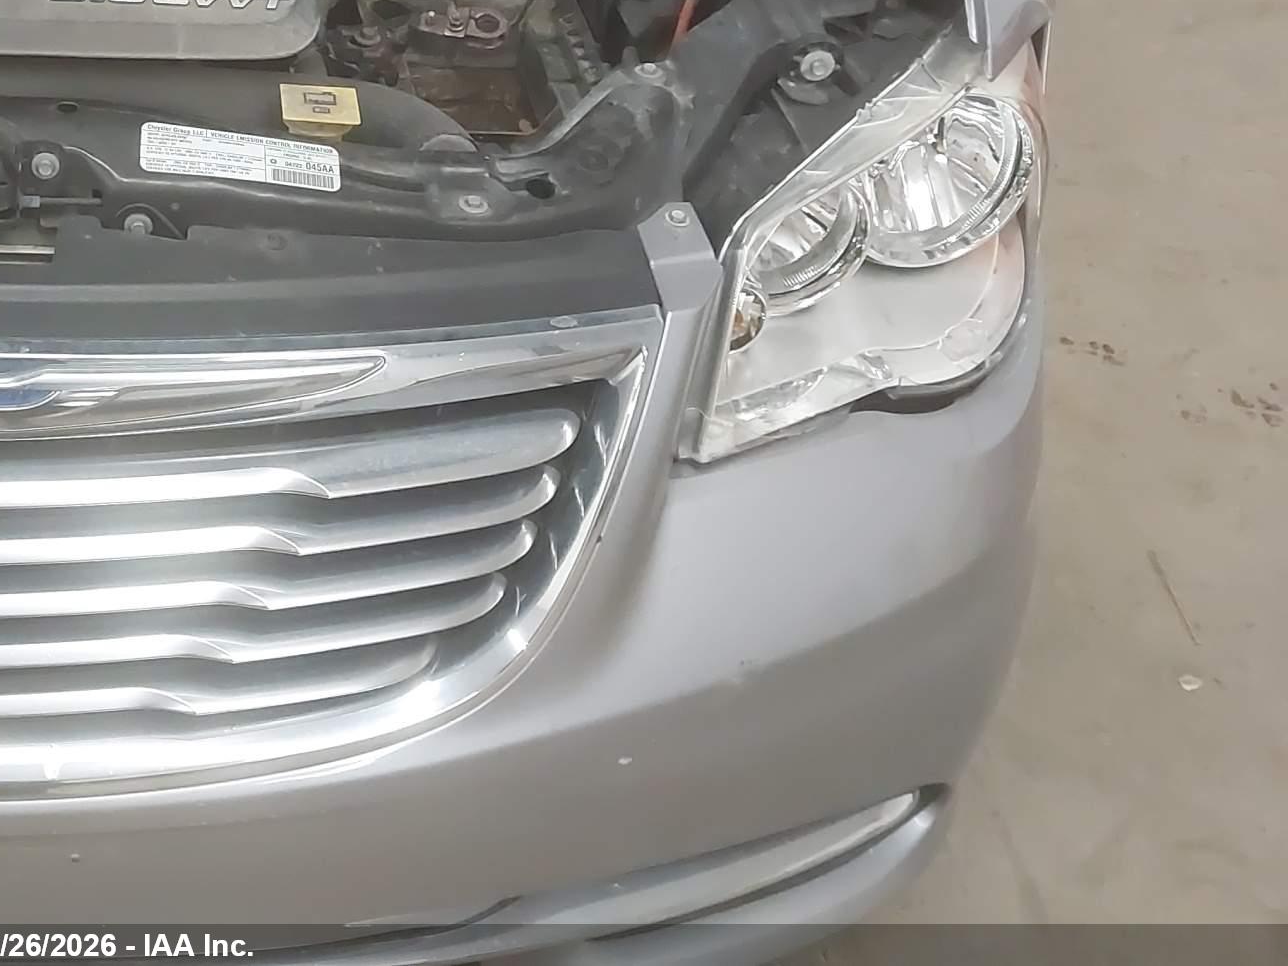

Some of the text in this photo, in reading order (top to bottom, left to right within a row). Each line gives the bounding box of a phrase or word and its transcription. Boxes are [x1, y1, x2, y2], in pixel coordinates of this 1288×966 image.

[147, 123, 172, 132] Chrysler
[210, 131, 235, 139] VEHICLE
[236, 135, 264, 144] EMISSION
[265, 139, 291, 148] CONTROL
[292, 143, 333, 153] INFORMATION
[305, 162, 335, 174] 045AA
